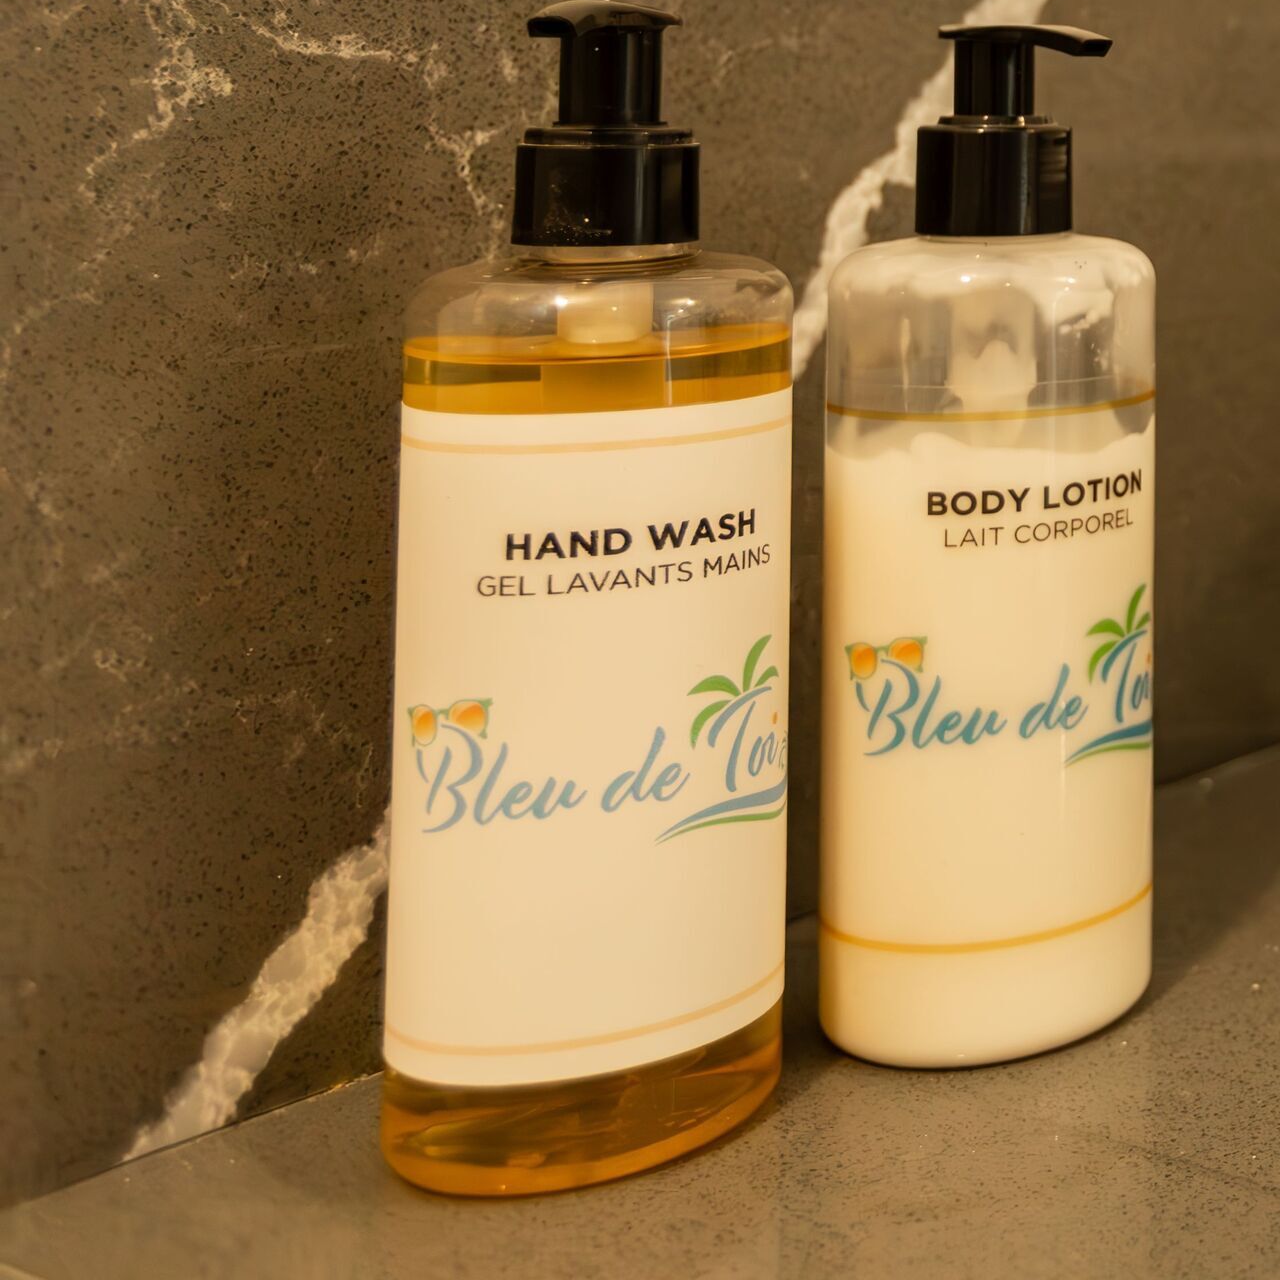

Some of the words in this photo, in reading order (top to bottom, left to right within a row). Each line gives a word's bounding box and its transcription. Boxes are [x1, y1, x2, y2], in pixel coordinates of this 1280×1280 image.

[926, 487, 1031, 516] BODY
[1043, 468, 1142, 510] LOTION
[505, 527, 632, 561] HAND
[647, 508, 756, 551] WASH
[944, 526, 1005, 547] LAIT
[1014, 508, 1134, 544] CORPOREL
[476, 575, 536, 597] GEL
[546, 561, 693, 595] LAVANTS
[702, 543, 770, 578] MAINS
[855, 658, 1008, 757] Bleu
[1019, 663, 1089, 740] de
[416, 723, 588, 833] Bleu
[601, 726, 691, 813] de
